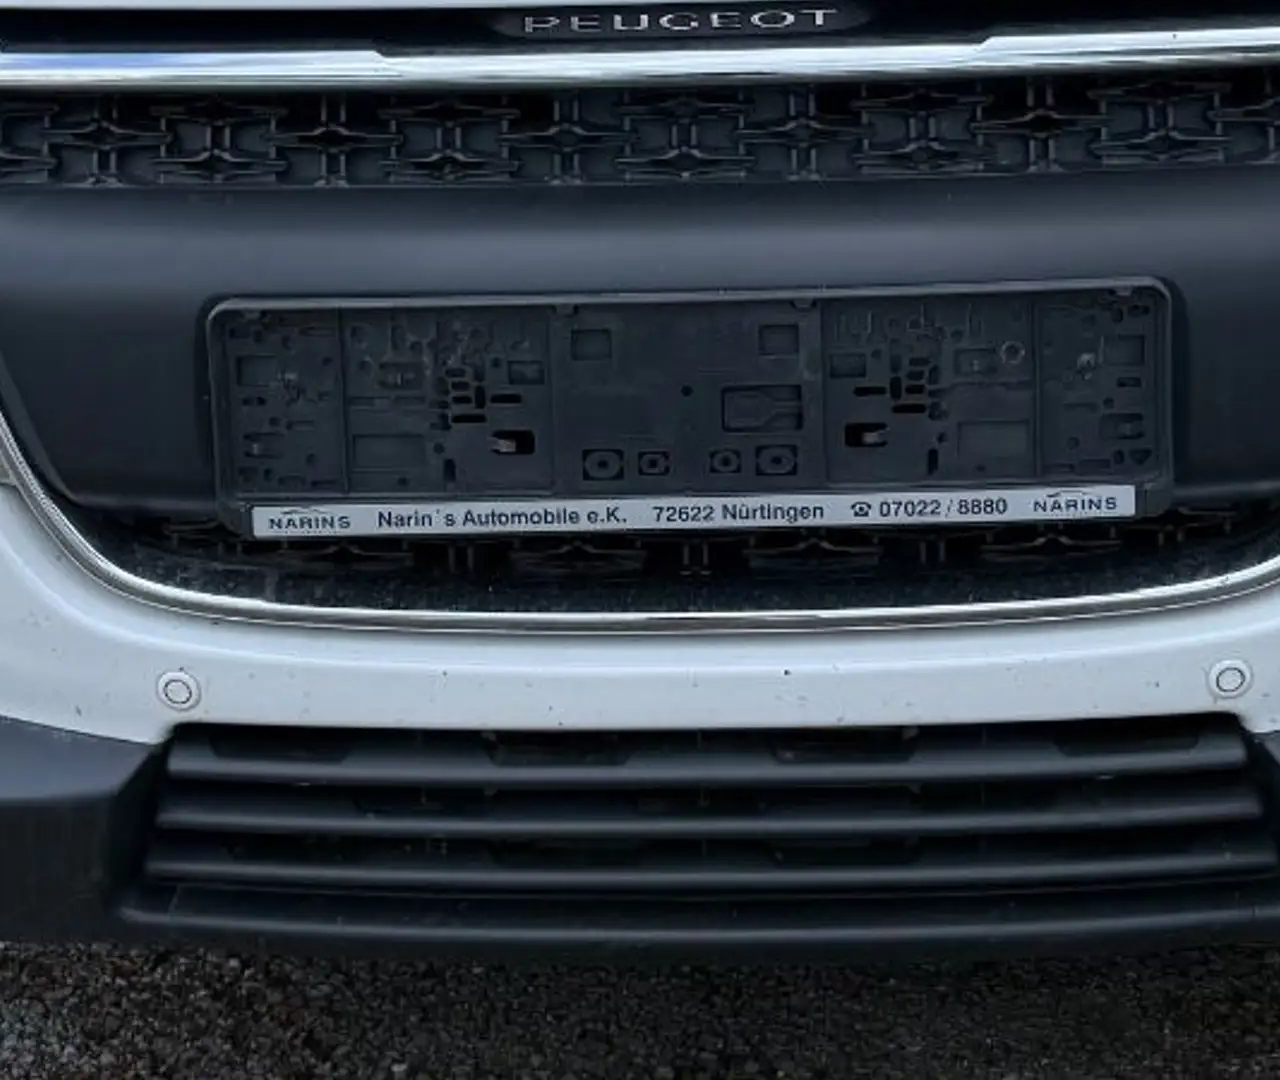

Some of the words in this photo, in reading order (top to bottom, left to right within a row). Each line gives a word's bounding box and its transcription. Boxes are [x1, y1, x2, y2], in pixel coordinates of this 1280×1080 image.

[524, 9, 838, 33] PEUGEOT
[462, 506, 580, 527] Automobile
[586, 505, 627, 525] e.K.
[652, 504, 715, 522] 72622
[721, 503, 824, 524] Nürtingen
[879, 499, 941, 518] 07022
[957, 496, 1009, 515] 8880
[1033, 496, 1118, 512] NARINS
[268, 515, 352, 529] NARINS
